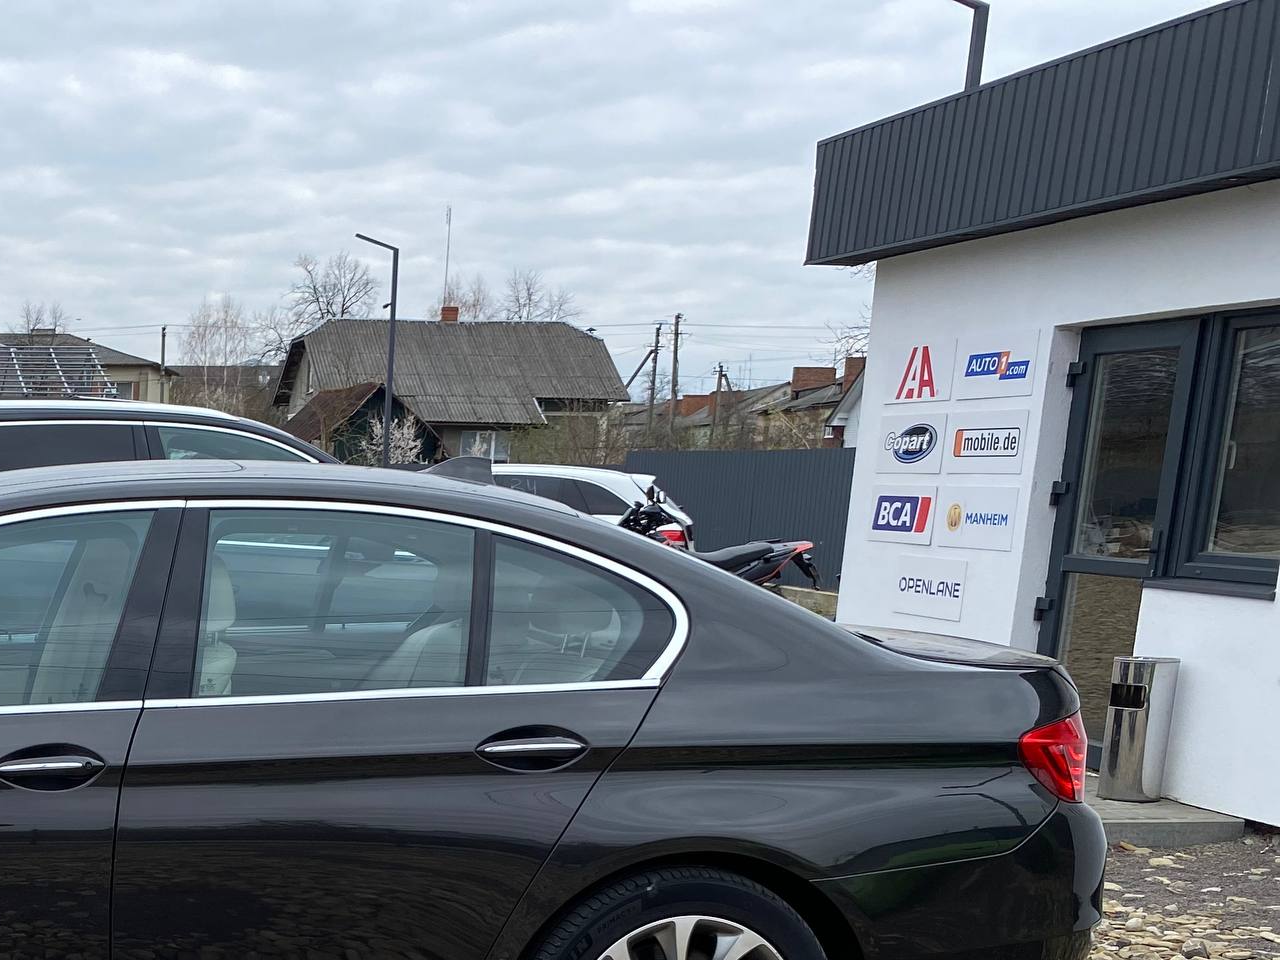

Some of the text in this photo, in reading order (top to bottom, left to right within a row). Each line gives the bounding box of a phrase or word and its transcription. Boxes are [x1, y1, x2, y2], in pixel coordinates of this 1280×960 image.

[884, 431, 931, 453] Copart
[963, 432, 1017, 451] mobile.de
[877, 501, 911, 527] BCA
[965, 512, 1009, 526] MANHEIM
[898, 576, 961, 599] OPENLANE
